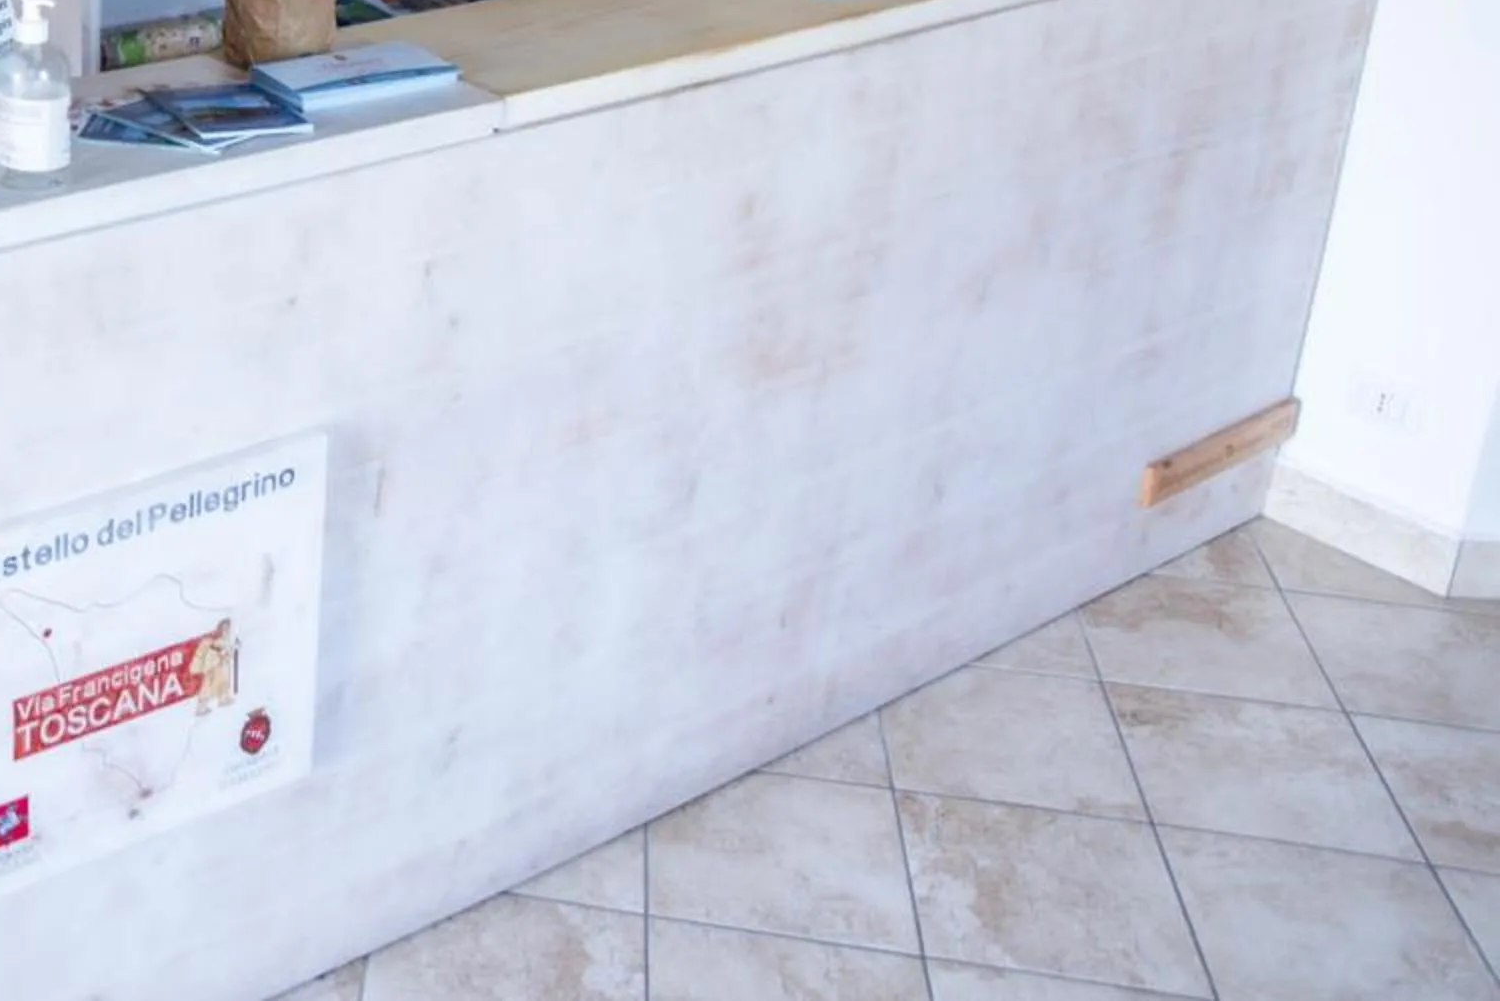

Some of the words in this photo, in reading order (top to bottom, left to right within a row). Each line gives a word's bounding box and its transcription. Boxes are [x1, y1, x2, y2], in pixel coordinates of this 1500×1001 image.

[97, 510, 143, 548] del
[147, 466, 297, 533] Pellegrino
[16, 686, 58, 723] Via
[59, 649, 185, 709] Francigena
[16, 675, 185, 753] TOSCANA
